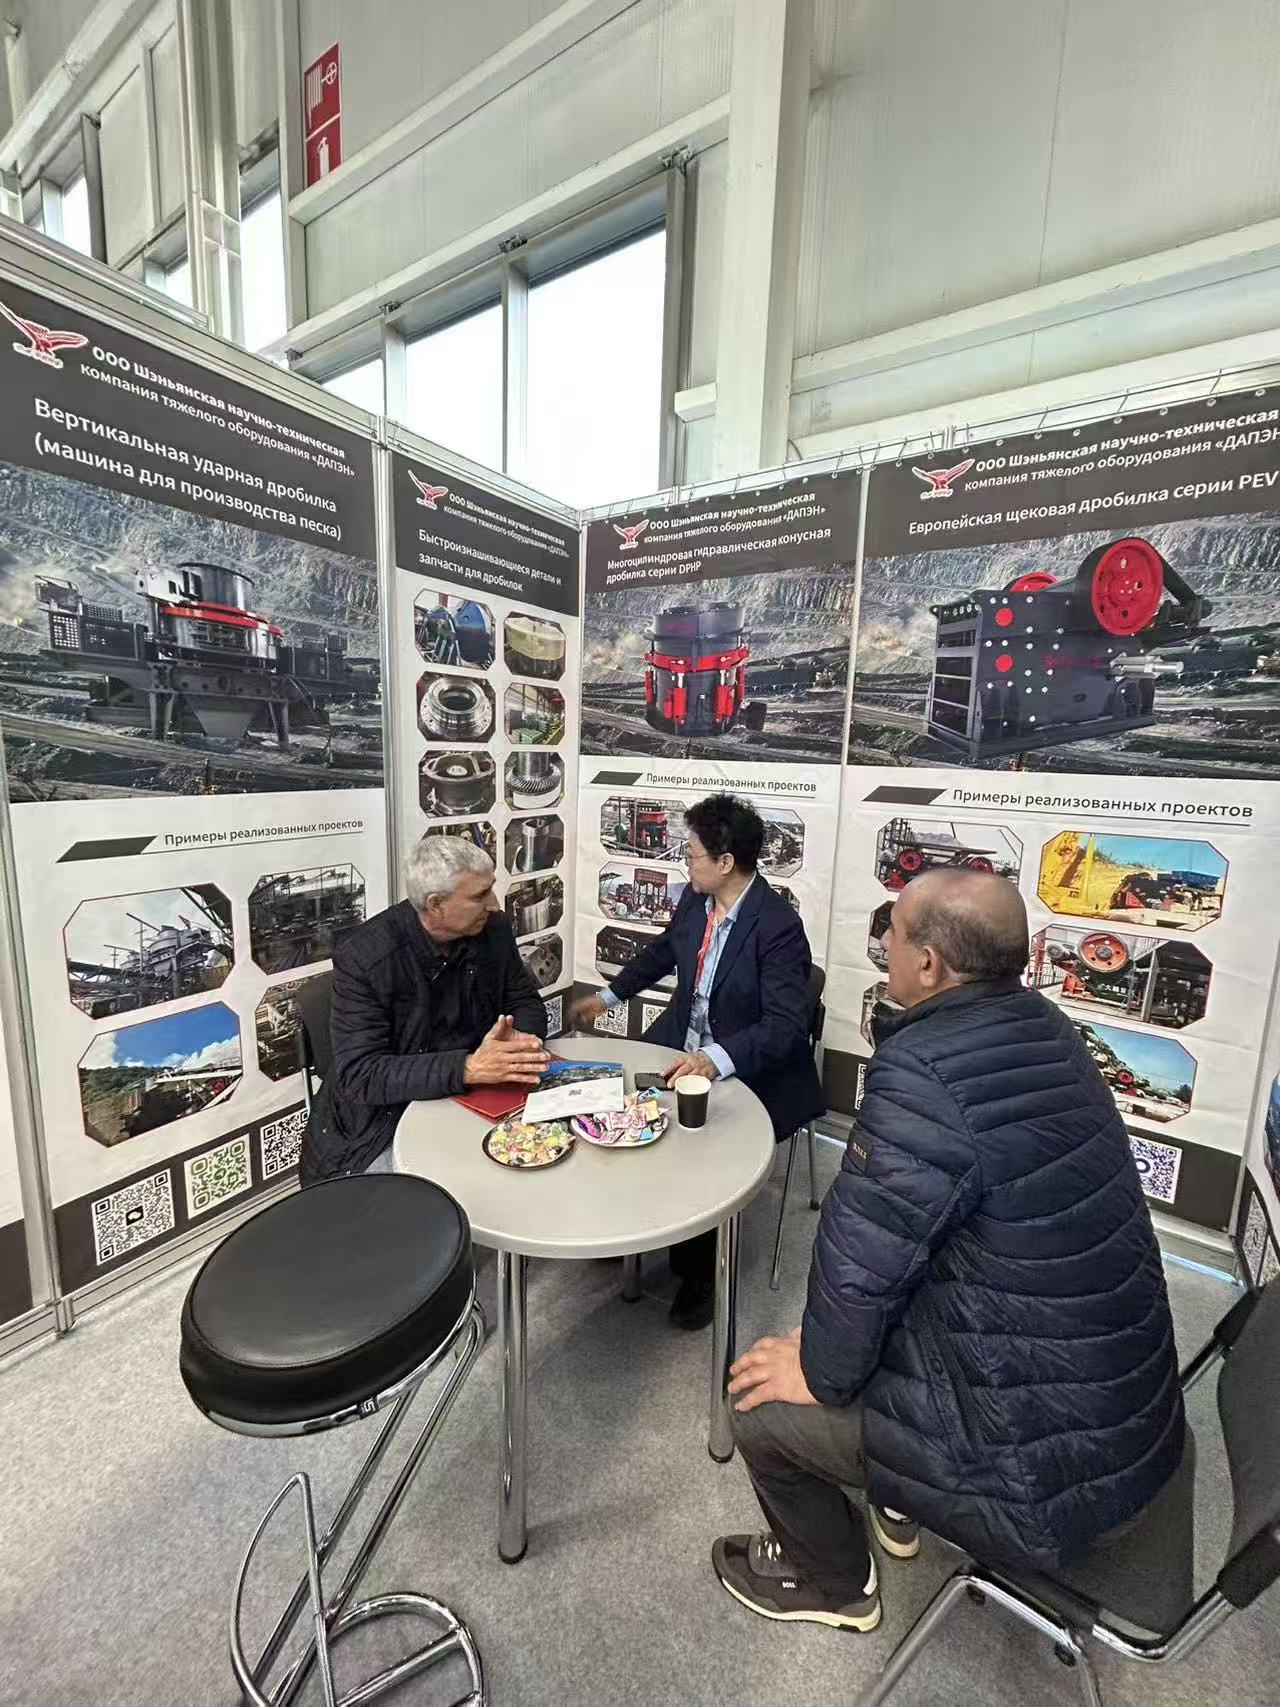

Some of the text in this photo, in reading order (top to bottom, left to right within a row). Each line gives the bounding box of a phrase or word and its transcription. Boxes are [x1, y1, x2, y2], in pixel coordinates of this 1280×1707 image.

[80, 363, 356, 477] компания тяжелого оборудования «ДАПЭН»
[92, 346, 131, 372] ООО
[133, 362, 226, 410] Шэньянская
[227, 403, 346, 459] научно-техническая
[34, 397, 338, 513] Вертикальная ударная дробилка
[976, 409, 1279, 472] ООО Шэньянская научно-техническая
[34, 431, 342, 542] (машина для производства песка)
[964, 472, 1028, 492] компания
[1031, 460, 1095, 482] тяжелого
[1097, 441, 1212, 470] оборудования
[449, 493, 466, 507] ООО
[466, 499, 508, 524] Шэньянская
[507, 518, 565, 546] научно-техническая
[643, 504, 827, 545] компания тяжелого оборудования «ДАПЭН»
[650, 492, 816, 530] ООО Шэньянская научно-техническая
[908, 470, 1280, 535] Европейская щековая дробилка серии PEV
[443, 505, 478, 524] компания
[477, 517, 507, 536] тяжелого
[507, 529, 548, 550] оборудования
[607, 527, 832, 571] Многоцилиндровая гидравлическая конусная
[418, 529, 562, 585] Быстроизнашивающиеся детали и
[418, 552, 524, 593] запчасти для дробилок
[606, 560, 702, 585] дробилка серии DPHP
[646, 772, 817, 793] Примеры реализованных проектов
[952, 789, 1254, 818] Примеры реализованных проектов
[164, 818, 364, 848] Примеры реализованных проектов
